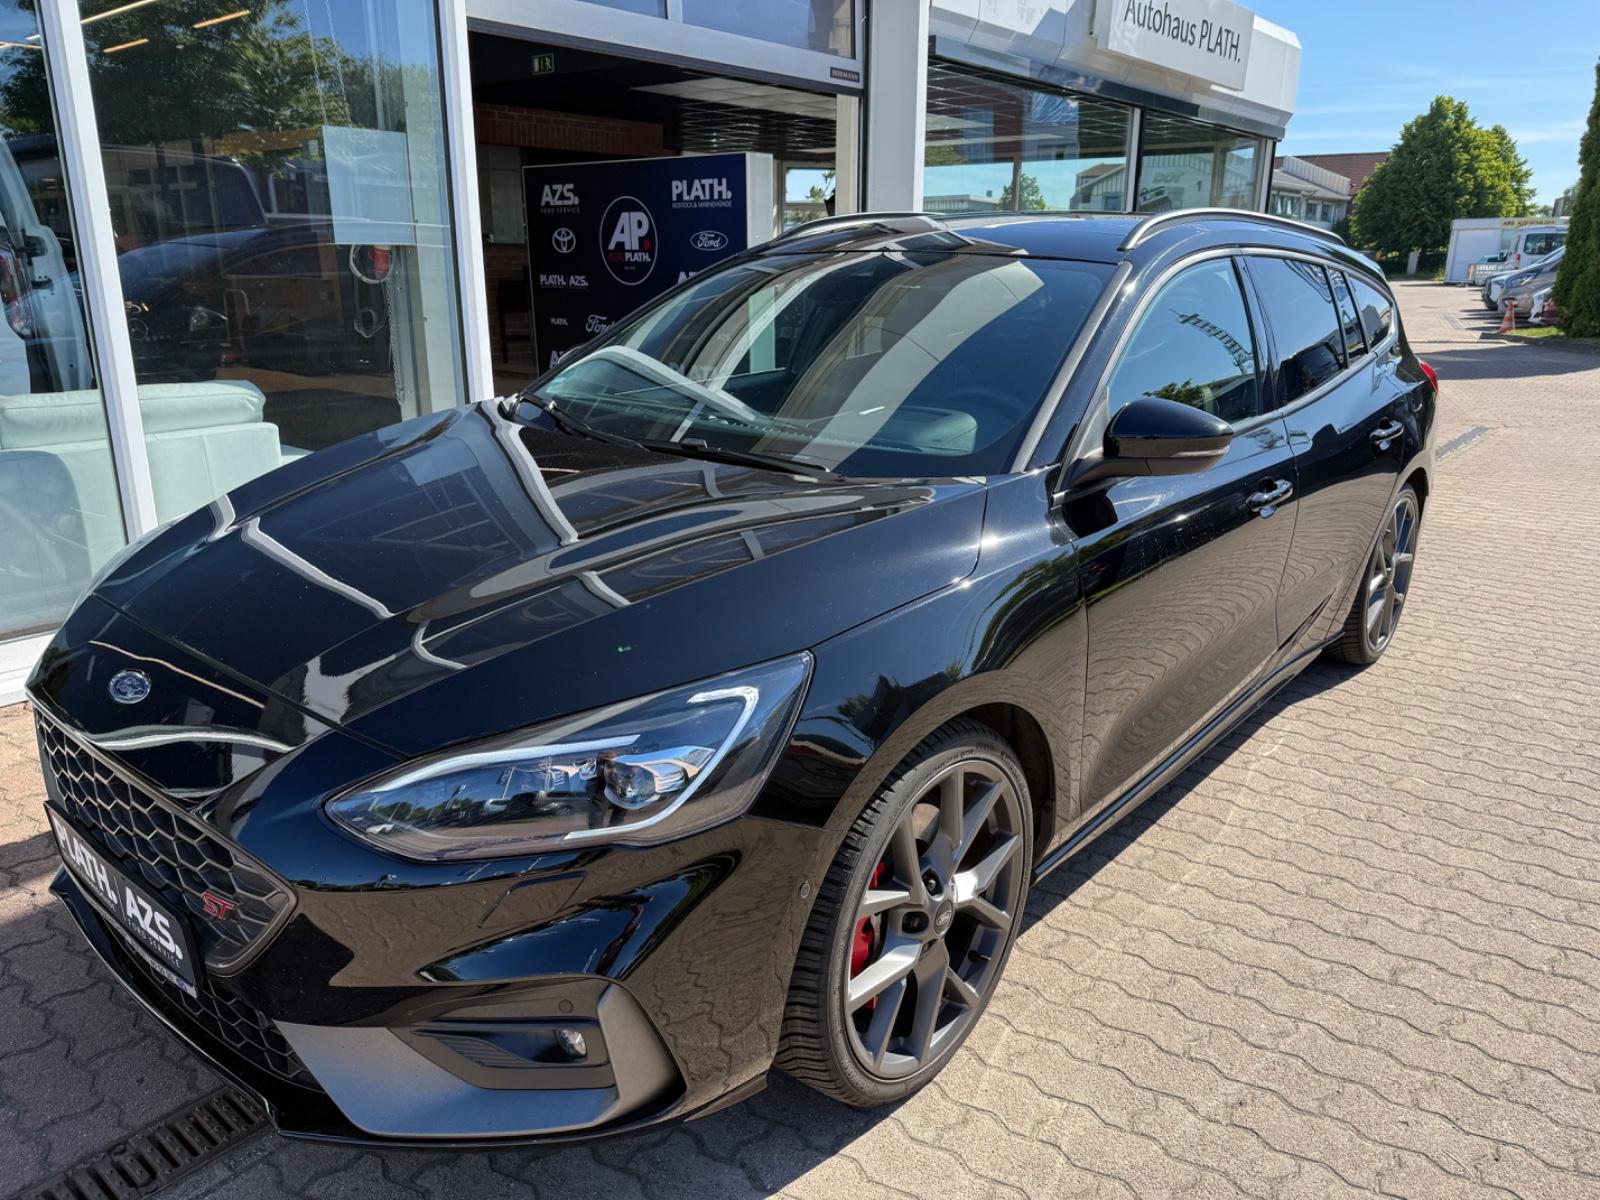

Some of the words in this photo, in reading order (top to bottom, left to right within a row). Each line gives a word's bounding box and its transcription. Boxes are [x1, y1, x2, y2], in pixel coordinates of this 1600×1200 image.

[1123, 0, 1196, 47] Autohaus
[1198, 19, 1241, 63] PLATH.
[540, 183, 580, 206] AZS.
[671, 177, 733, 201] PLATH.
[697, 232, 721, 248] Ford
[539, 273, 566, 286] PLATH.
[569, 275, 589, 287] AZS.
[52, 815, 118, 905] PLATH.
[201, 892, 236, 920] ST
[126, 886, 183, 961] AZS.
